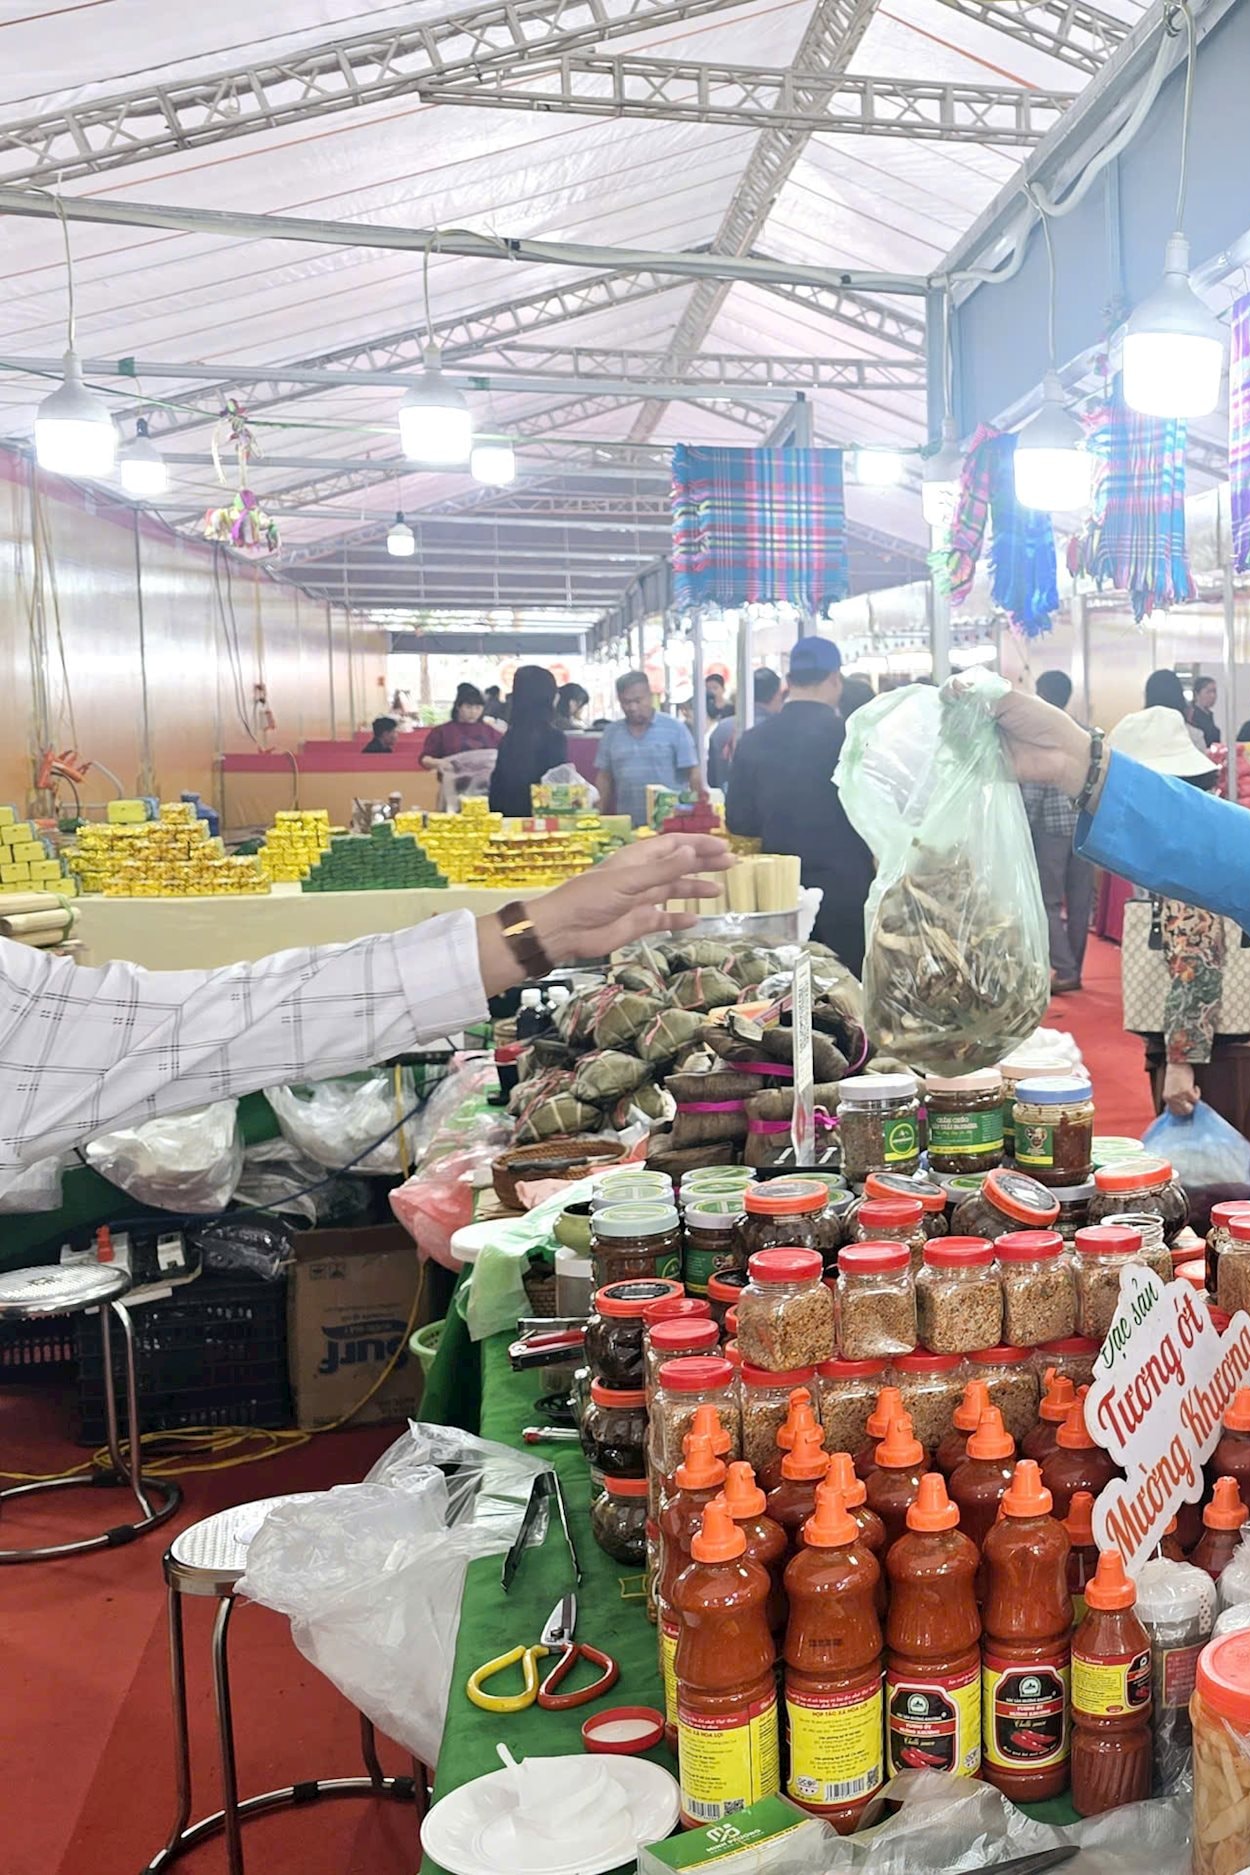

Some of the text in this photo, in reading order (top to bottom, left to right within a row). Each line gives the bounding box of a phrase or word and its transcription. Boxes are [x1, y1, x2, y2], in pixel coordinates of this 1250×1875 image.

[1131, 1277, 1159, 1326] sản
[1097, 1291, 1204, 1448] Tương ớt
[1105, 1433, 1195, 1567] Mường
